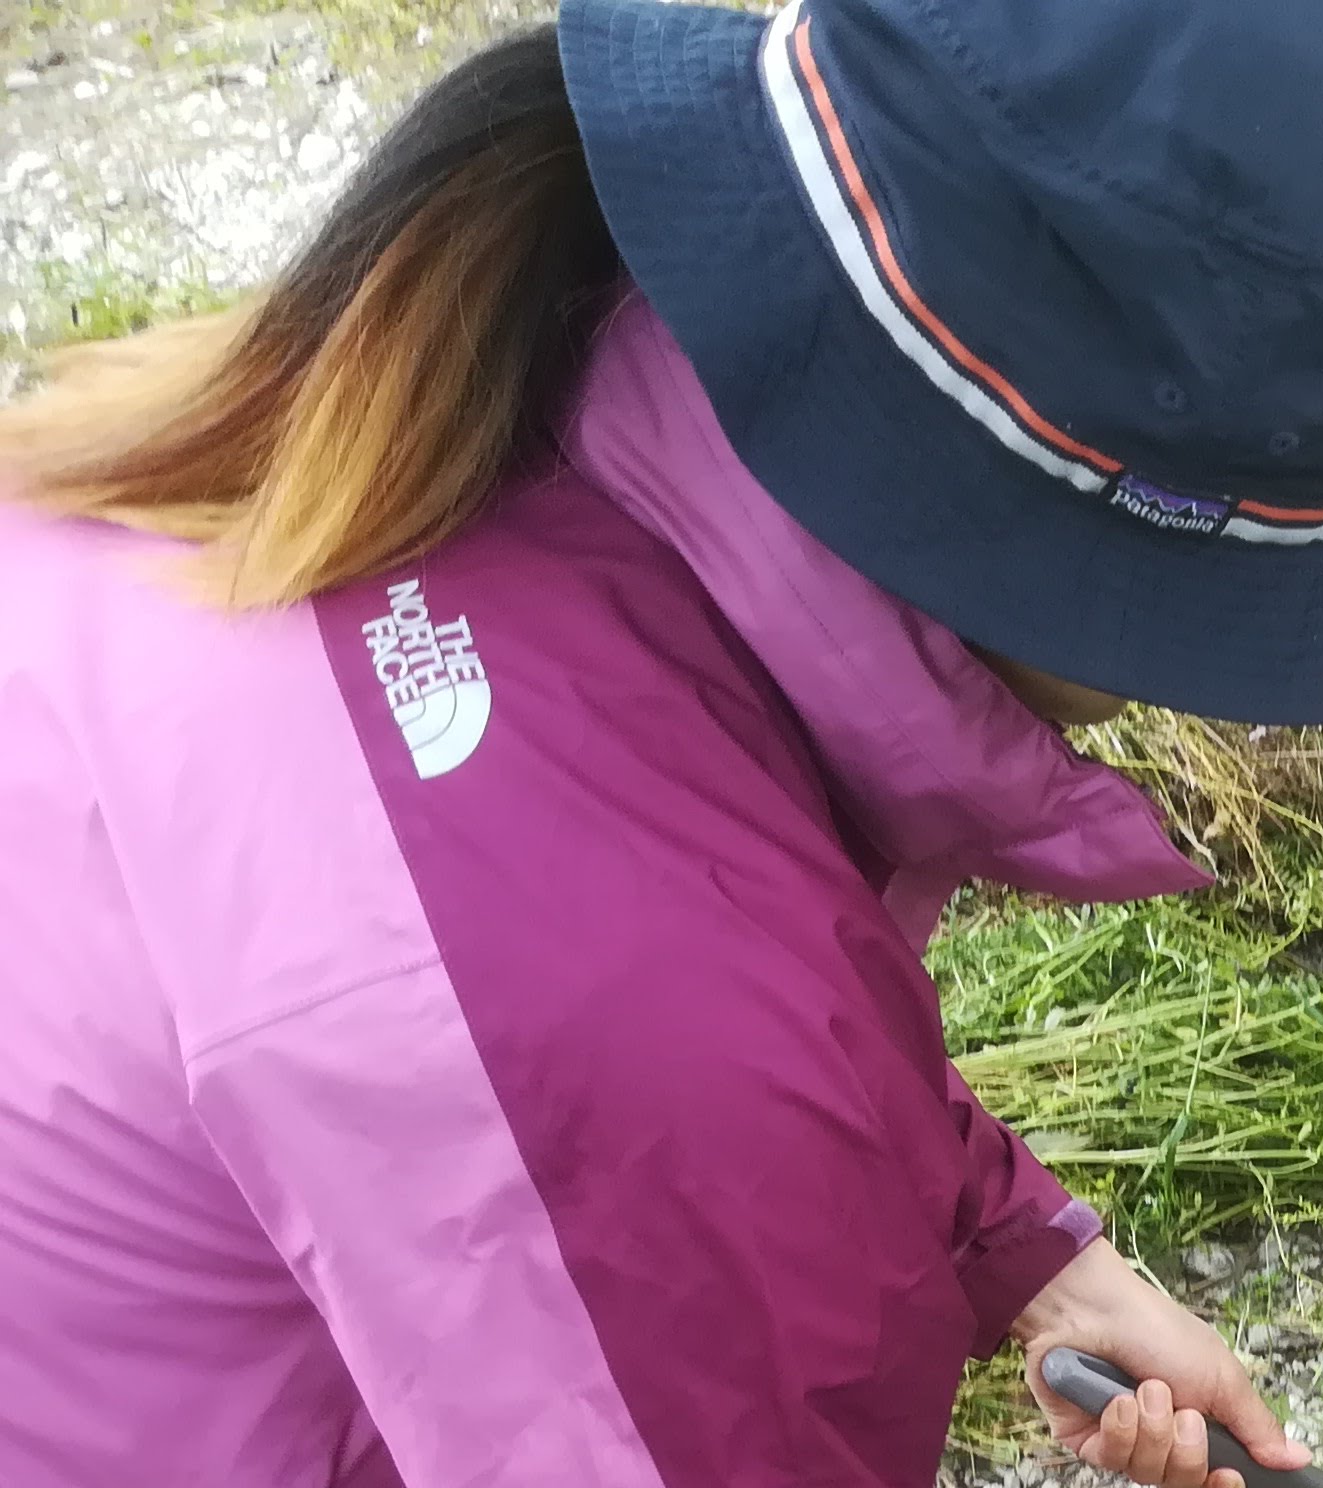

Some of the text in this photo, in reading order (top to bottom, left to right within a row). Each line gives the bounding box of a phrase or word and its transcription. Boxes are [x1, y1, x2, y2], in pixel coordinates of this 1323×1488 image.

[361, 614, 422, 710] FACE
[387, 578, 452, 697] NORTH
[435, 614, 486, 684] THE
